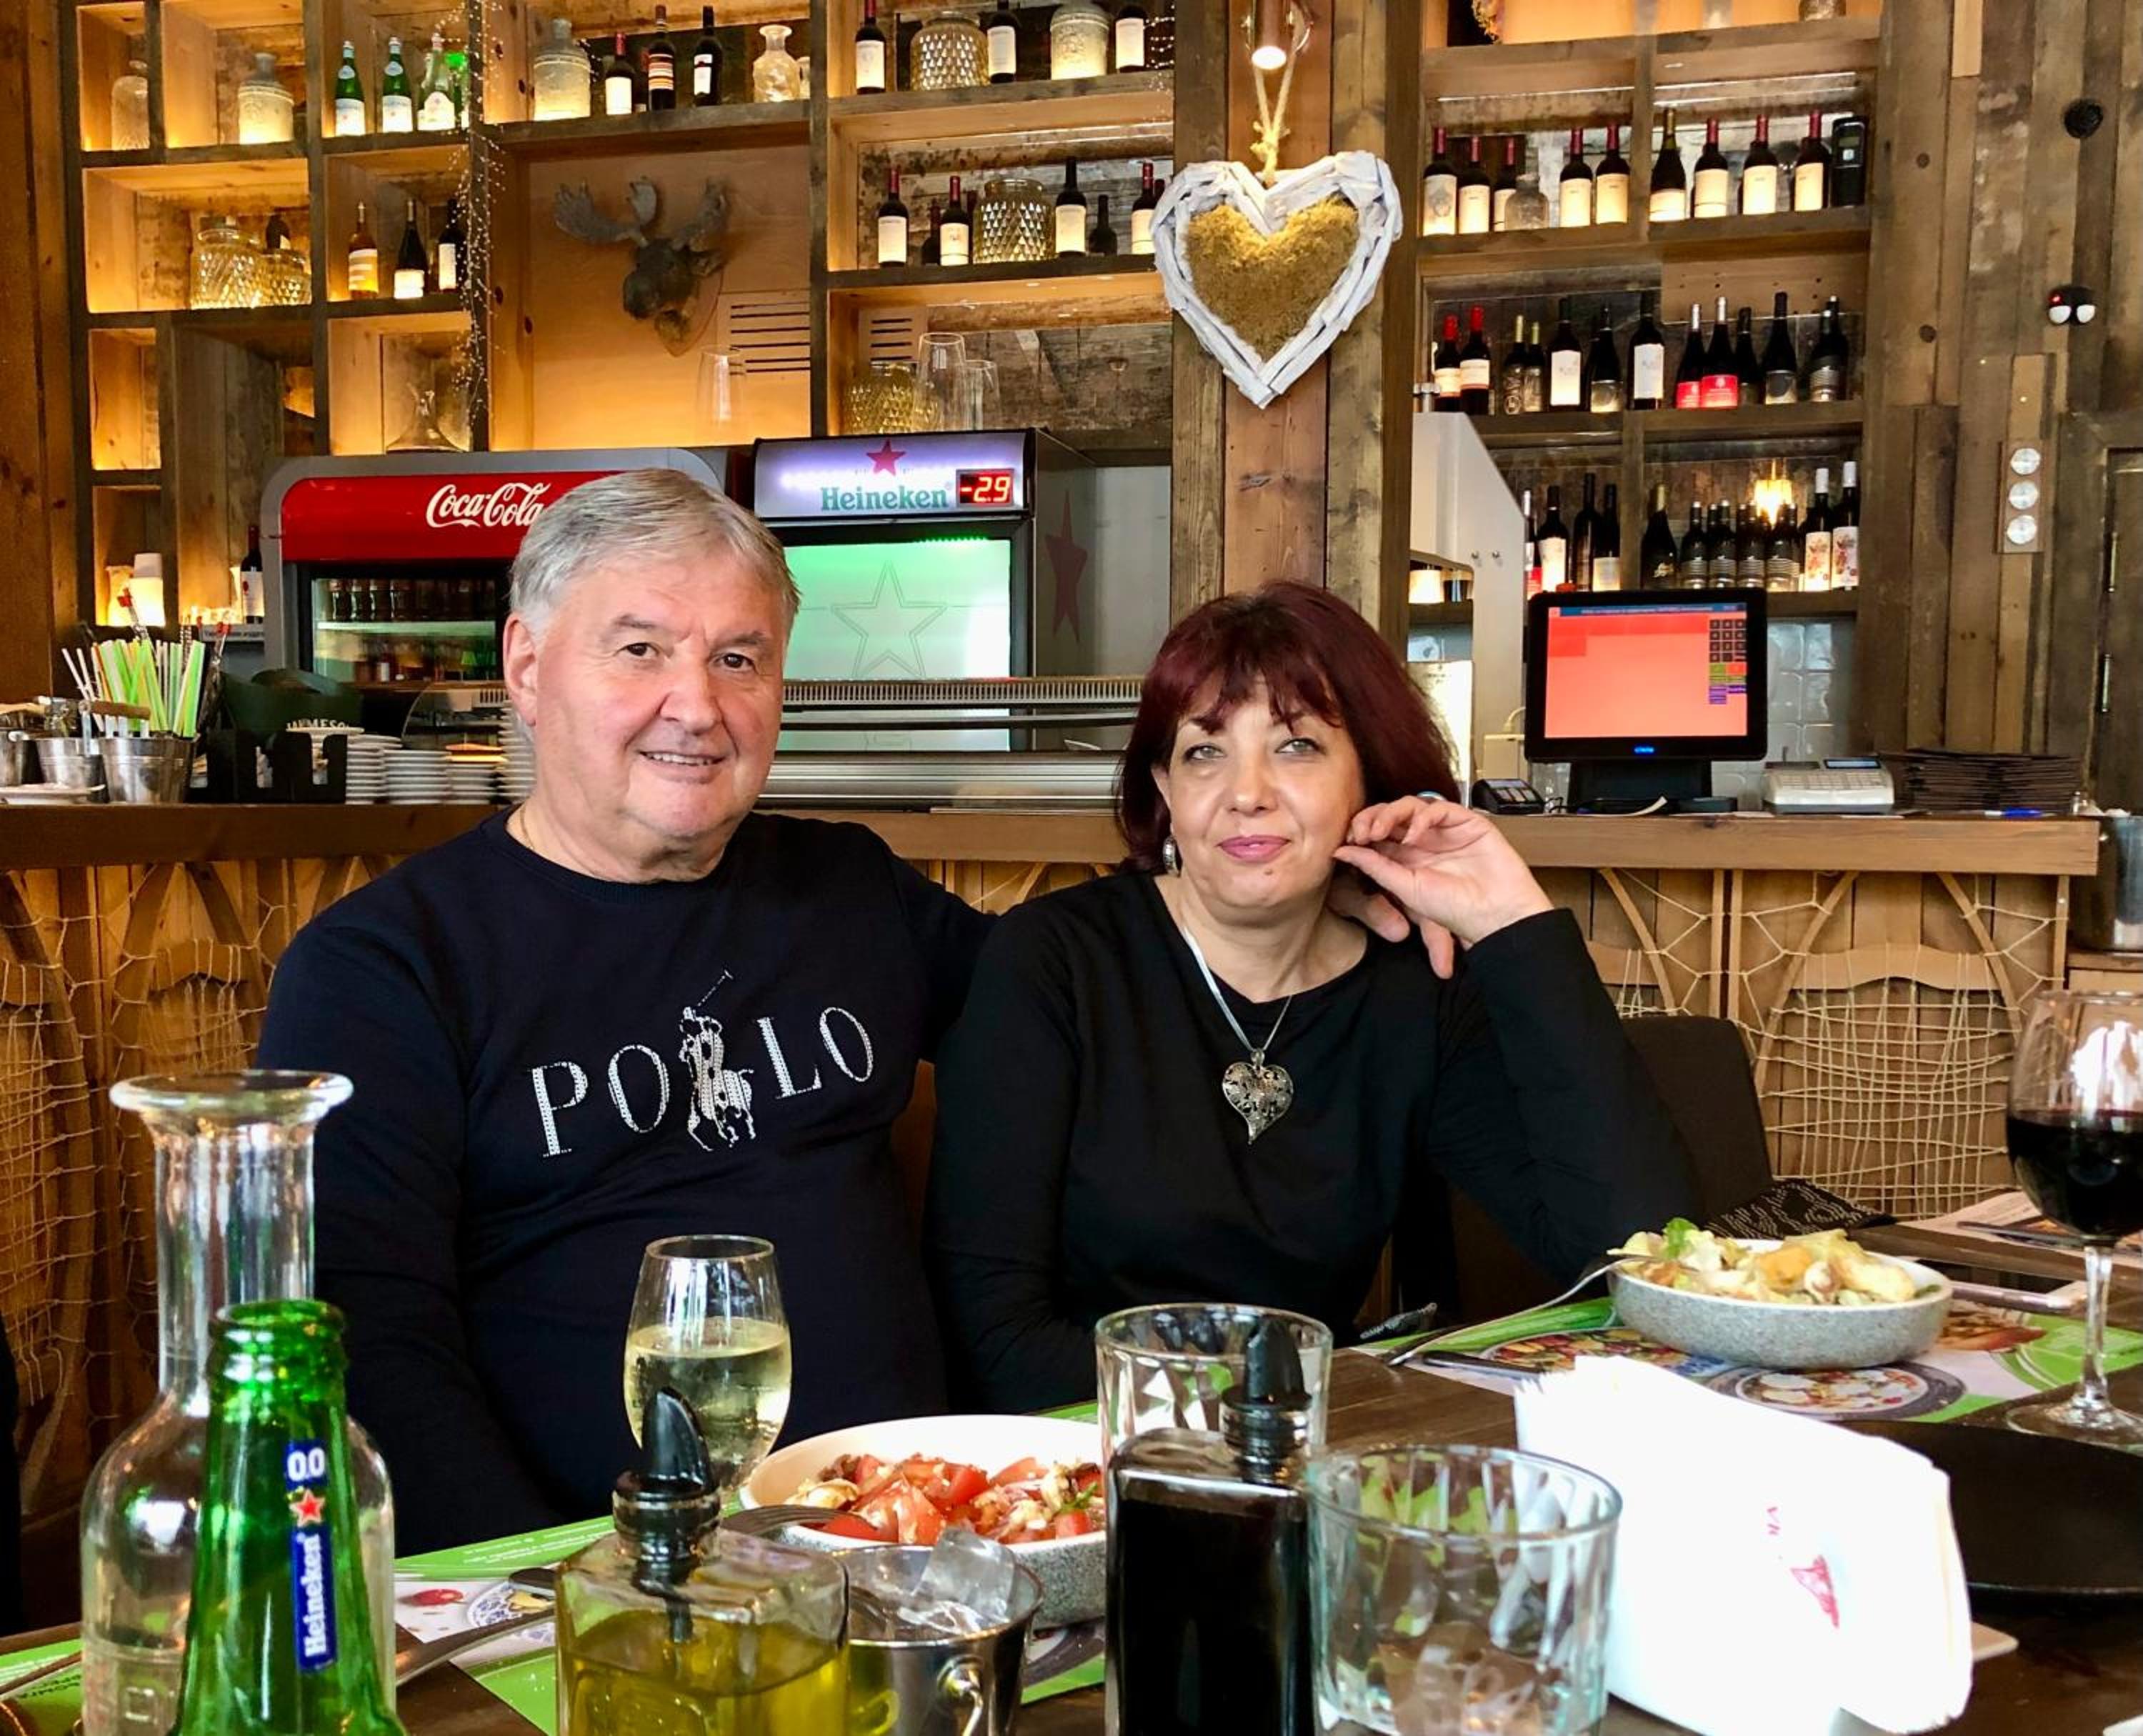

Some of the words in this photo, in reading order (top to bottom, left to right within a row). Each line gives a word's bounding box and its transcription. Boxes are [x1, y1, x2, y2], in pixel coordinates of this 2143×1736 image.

[426, 482, 551, 527] Coca-Cola
[821, 484, 949, 512] Heineken
[286, 719, 350, 729] JAMESO
[299, 1533, 326, 1657] Heineken
